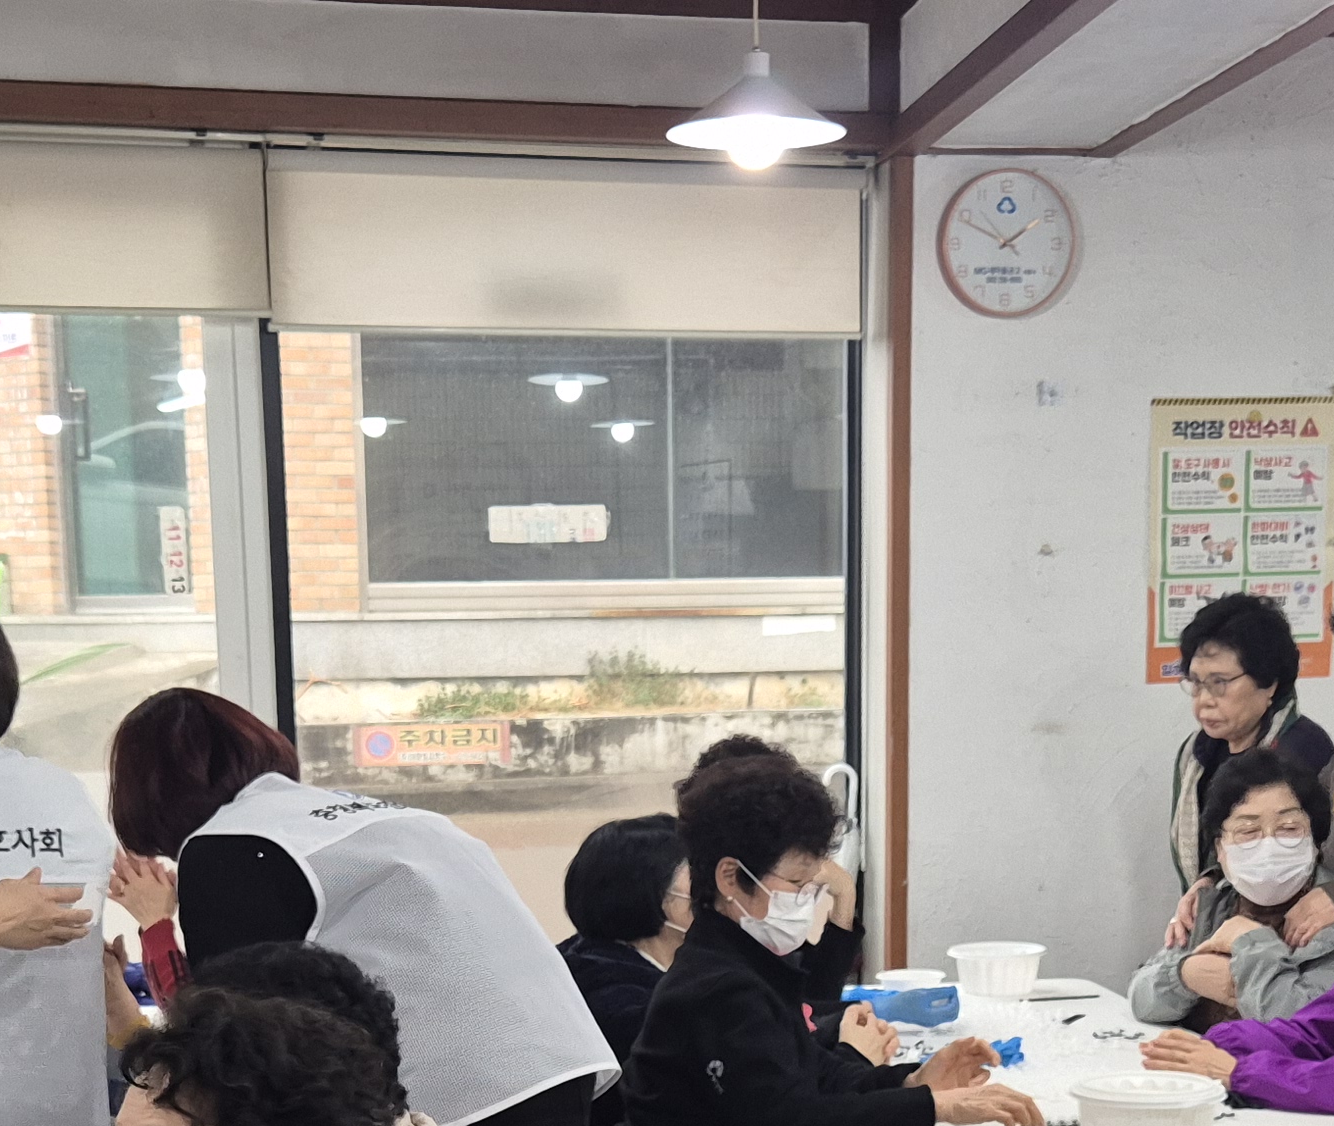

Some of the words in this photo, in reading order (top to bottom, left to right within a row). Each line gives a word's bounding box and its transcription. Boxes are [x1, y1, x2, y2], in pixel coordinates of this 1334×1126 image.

[1172, 419, 1224, 439] 작업장
[1229, 418, 1296, 439] 안전수칙
[399, 728, 499, 748] 주차금지
